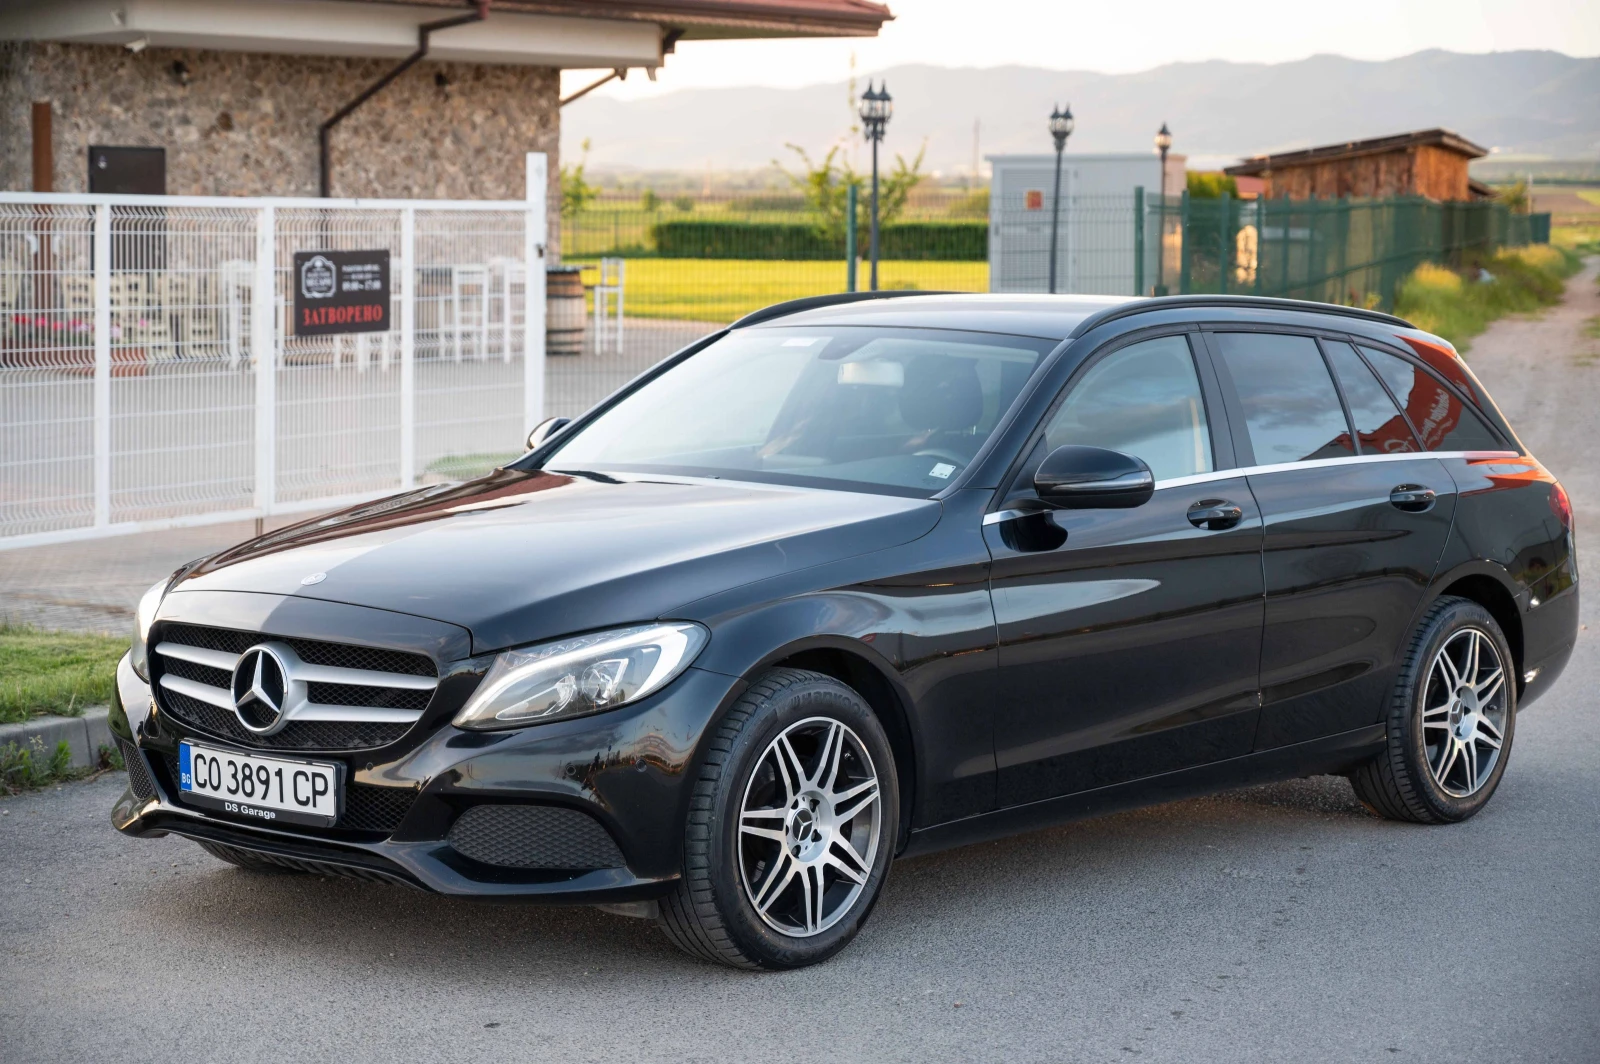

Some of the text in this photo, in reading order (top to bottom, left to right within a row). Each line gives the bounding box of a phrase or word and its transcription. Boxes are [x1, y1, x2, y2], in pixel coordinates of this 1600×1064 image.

[303, 304, 383, 326] ЗАТВОРЕНО
[181, 772, 191, 784] BG
[194, 753, 329, 808] CO 3891 CP
[225, 802, 276, 820] DS Garage
